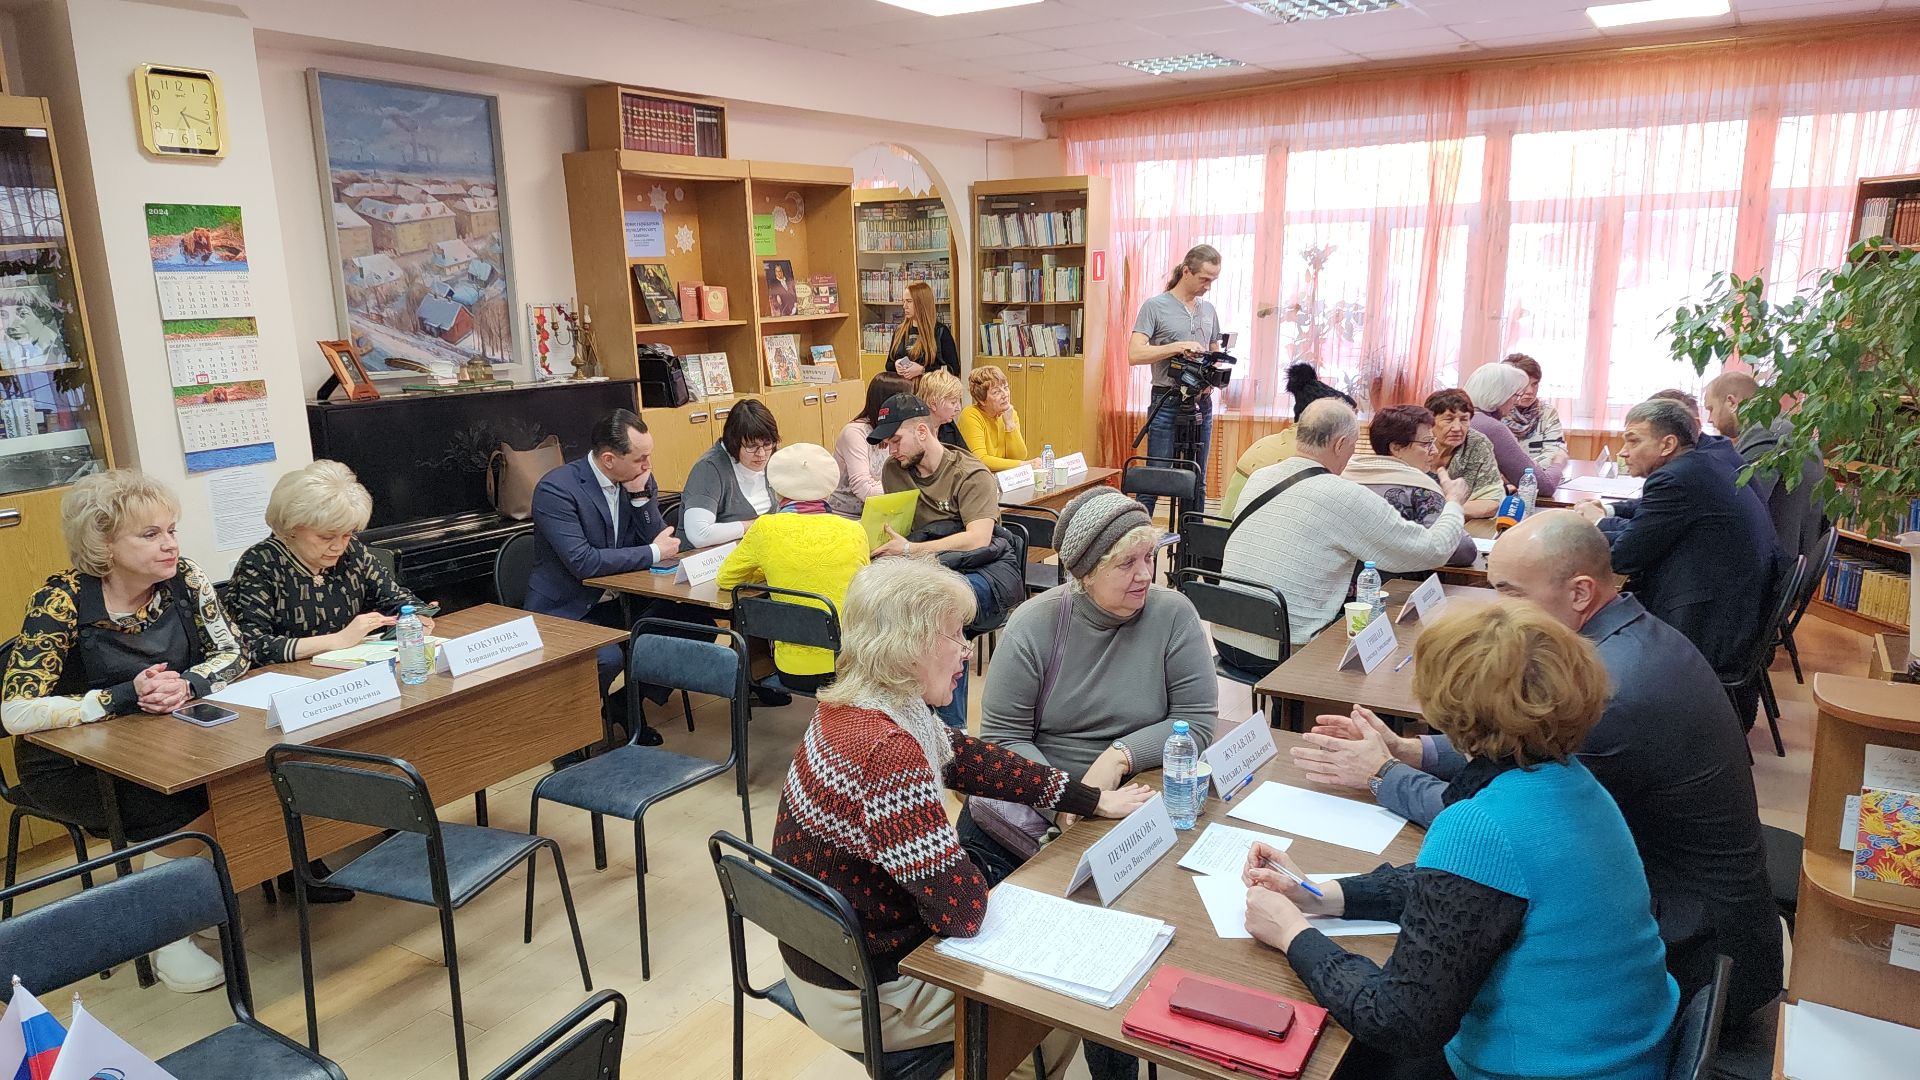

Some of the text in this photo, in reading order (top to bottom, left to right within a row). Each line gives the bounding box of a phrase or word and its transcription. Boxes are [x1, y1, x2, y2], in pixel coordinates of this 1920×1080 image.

[160, 80, 169, 90] 11
[175, 81, 183, 91] 12
[151, 90, 160, 100] 10
[203, 94, 208, 104] 2
[152, 105, 159, 115] 9
[205, 110, 210, 120] 3
[205, 127, 211, 136] 4
[168, 132, 174, 143] 7
[182, 133, 188, 144] 6
[197, 135, 203, 144] 5
[149, 208, 168, 216] 2024
[467, 631, 519, 653] КОКУНОВА
[465, 640, 529, 666] Марианна Юрьевна
[304, 677, 371, 705] СОКОЛОВА
[302, 689, 382, 719] Светлана Юрьевна
[1223, 730, 1256, 761] ЖУРАВЛЕВ
[1219, 742, 1271, 787] Михаил Аркадьевич
[1107, 819, 1157, 866] ПЕЧНИКОВА
[1114, 863, 1133, 883] Ольга
[1132, 836, 1164, 867] Викторовна
